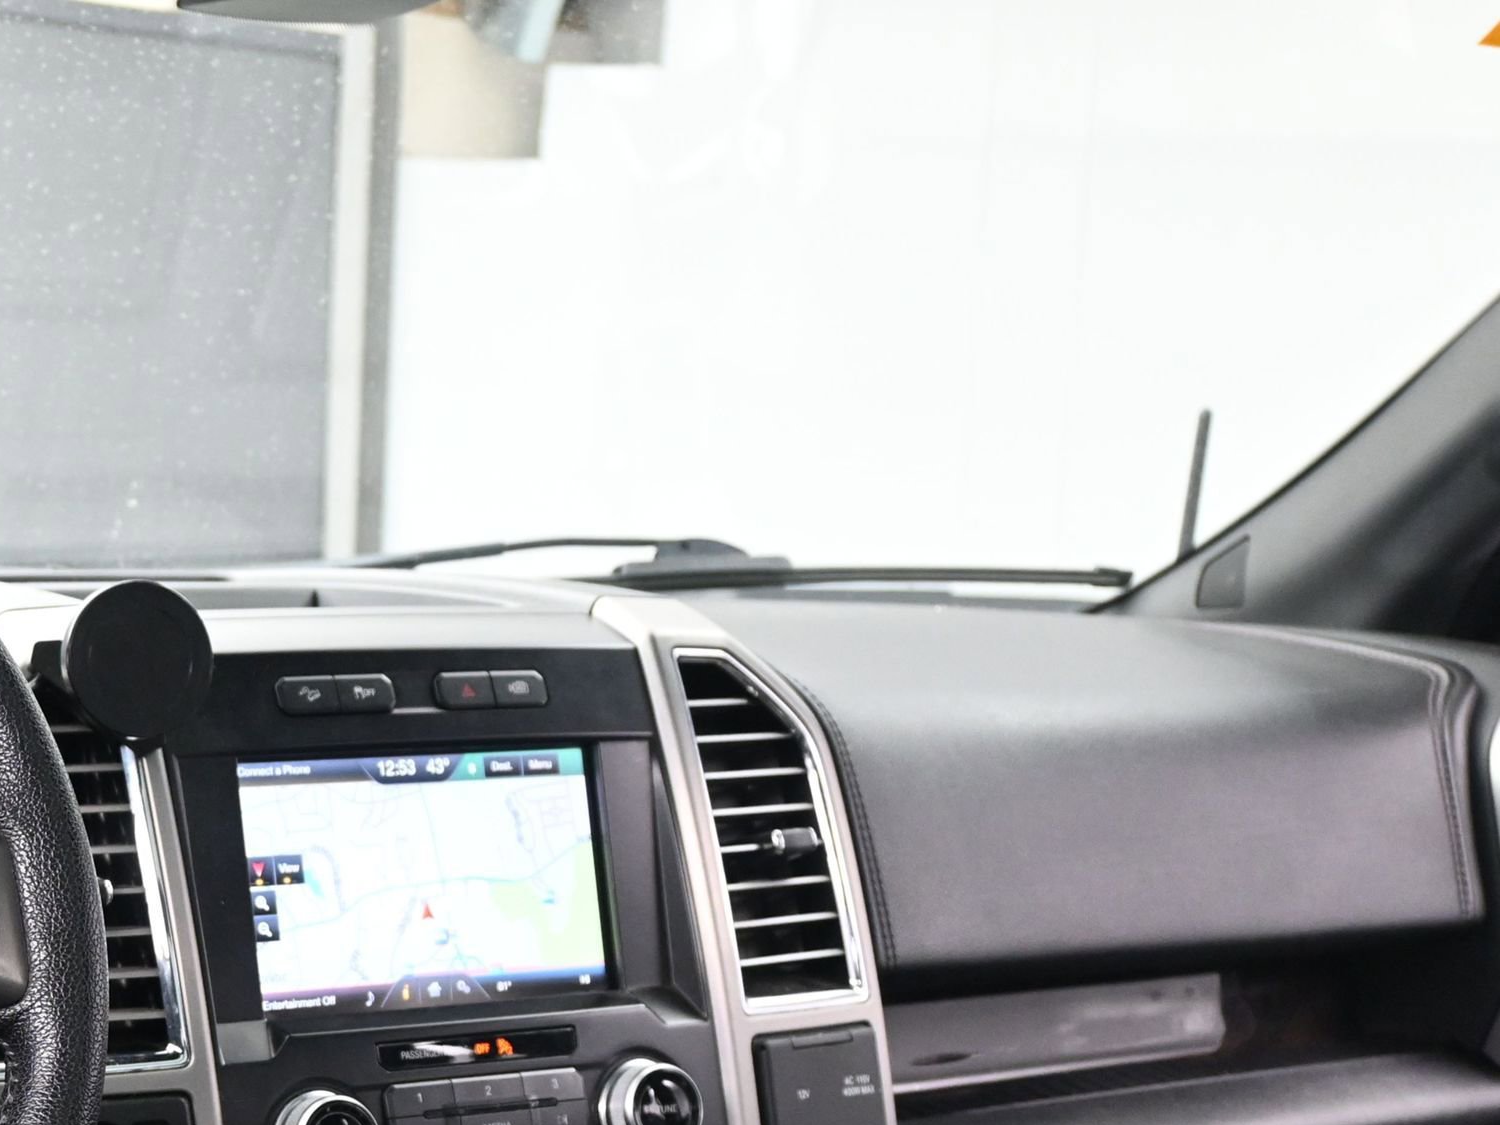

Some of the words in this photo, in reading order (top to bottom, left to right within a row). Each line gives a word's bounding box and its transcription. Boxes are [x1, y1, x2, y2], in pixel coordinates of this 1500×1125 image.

[378, 758, 416, 777] 12:53
[528, 759, 552, 770] Menu
[237, 766, 273, 777] Connect
[275, 767, 281, 776] a
[282, 764, 310, 775] Phone
[262, 998, 321, 1012] Entertainment
[321, 995, 336, 1006] Off
[474, 1043, 490, 1055] OFF
[551, 1078, 560, 1089] 3
[484, 1085, 492, 1096] 2
[417, 1092, 423, 1103] 1
